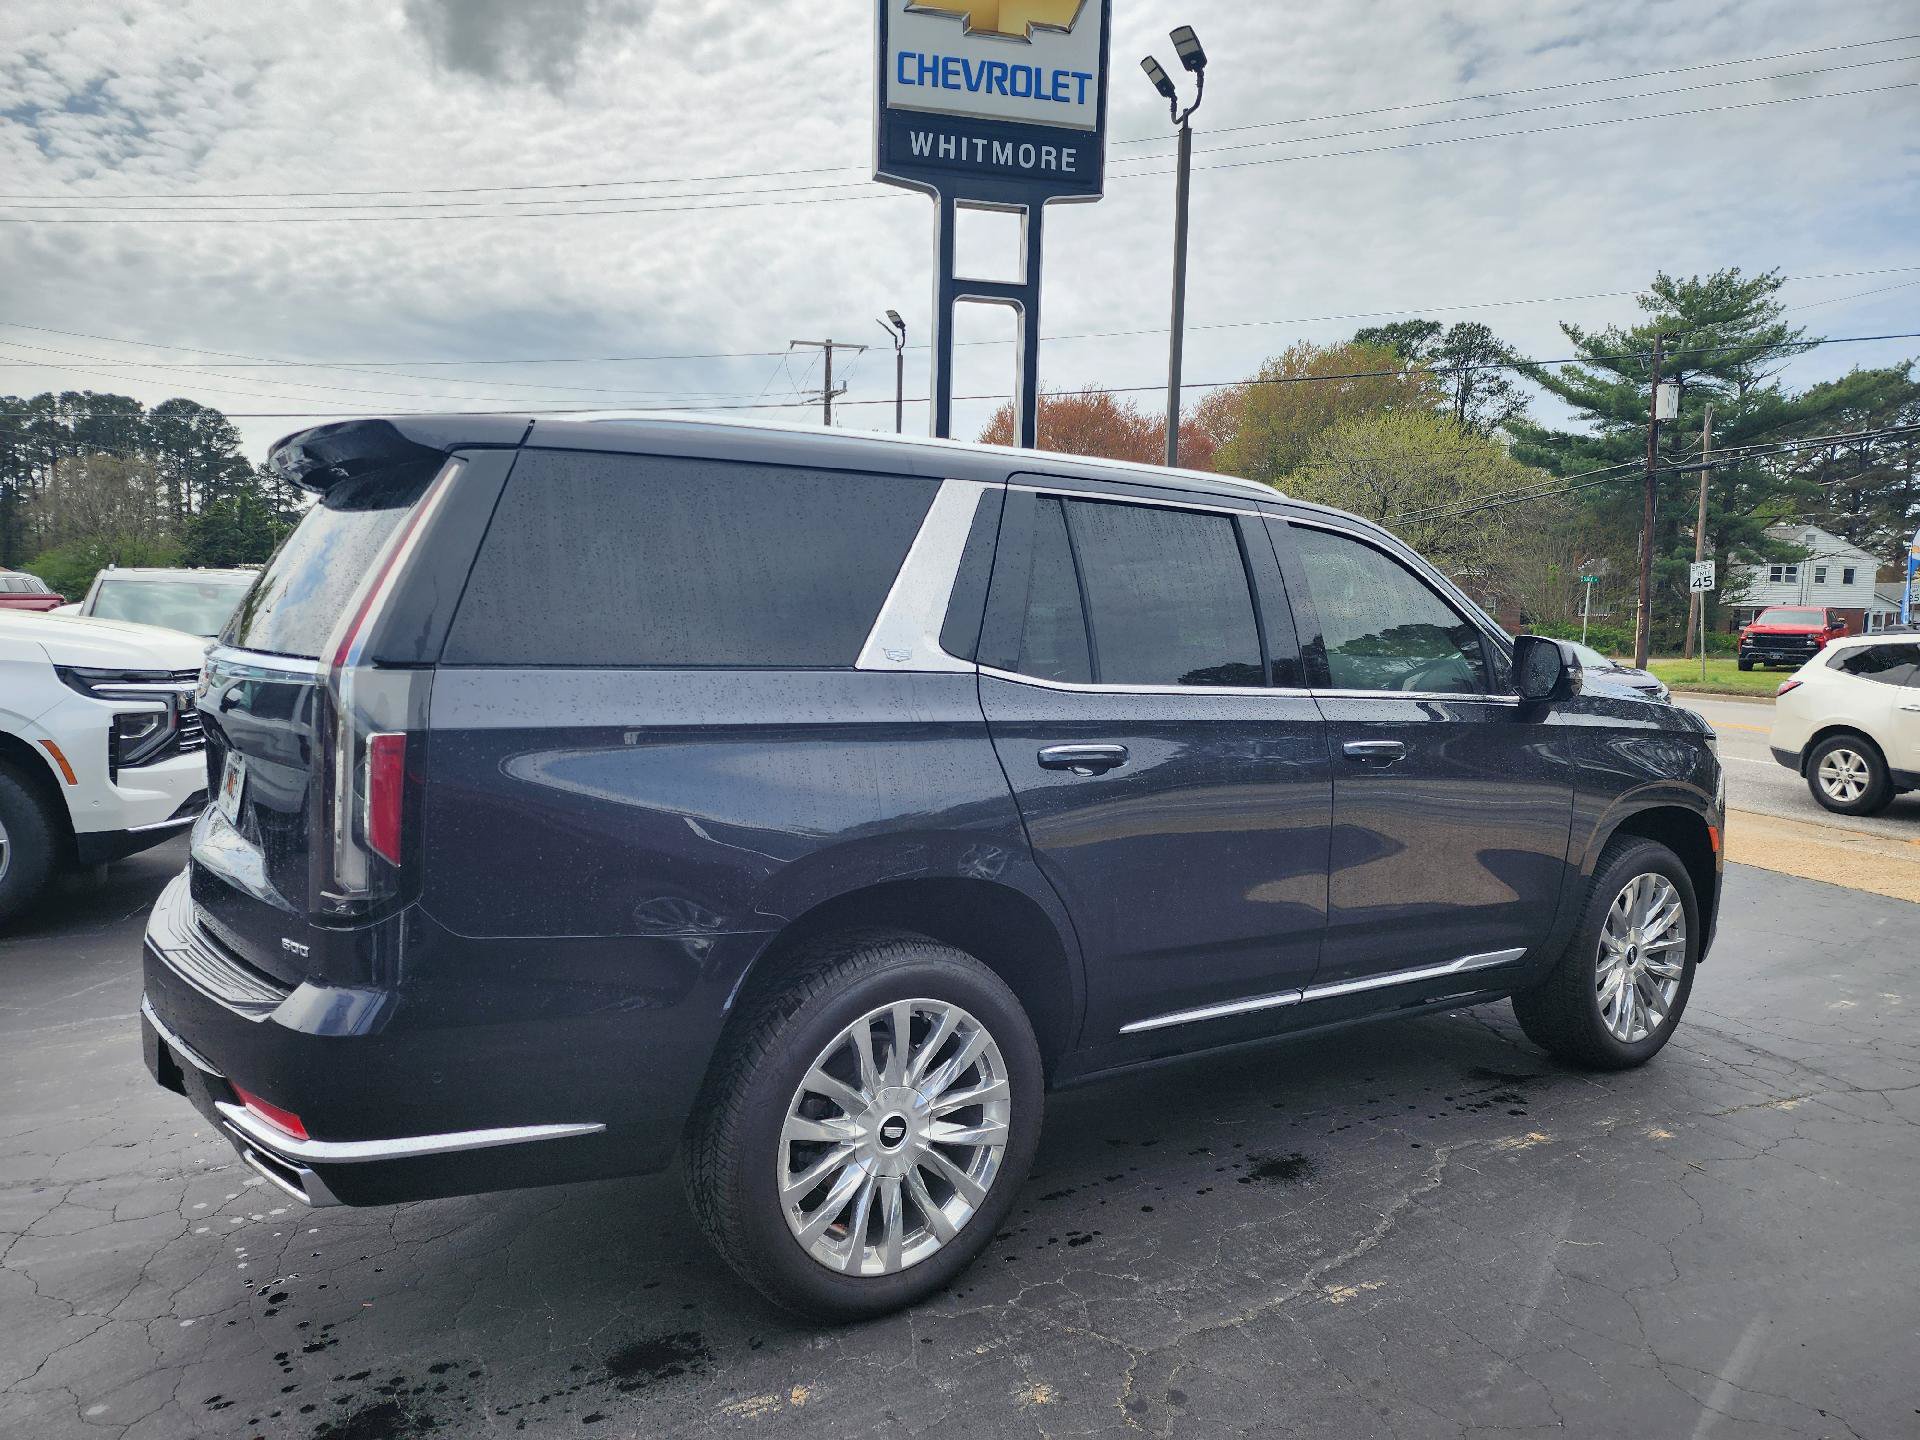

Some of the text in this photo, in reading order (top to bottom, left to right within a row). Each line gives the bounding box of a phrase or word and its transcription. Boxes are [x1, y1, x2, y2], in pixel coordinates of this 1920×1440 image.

[897, 51, 1093, 105] CHEVROLET
[910, 131, 1077, 172] WHITMORE
[1692, 575, 1713, 588] 45
[281, 937, 310, 958] 600
